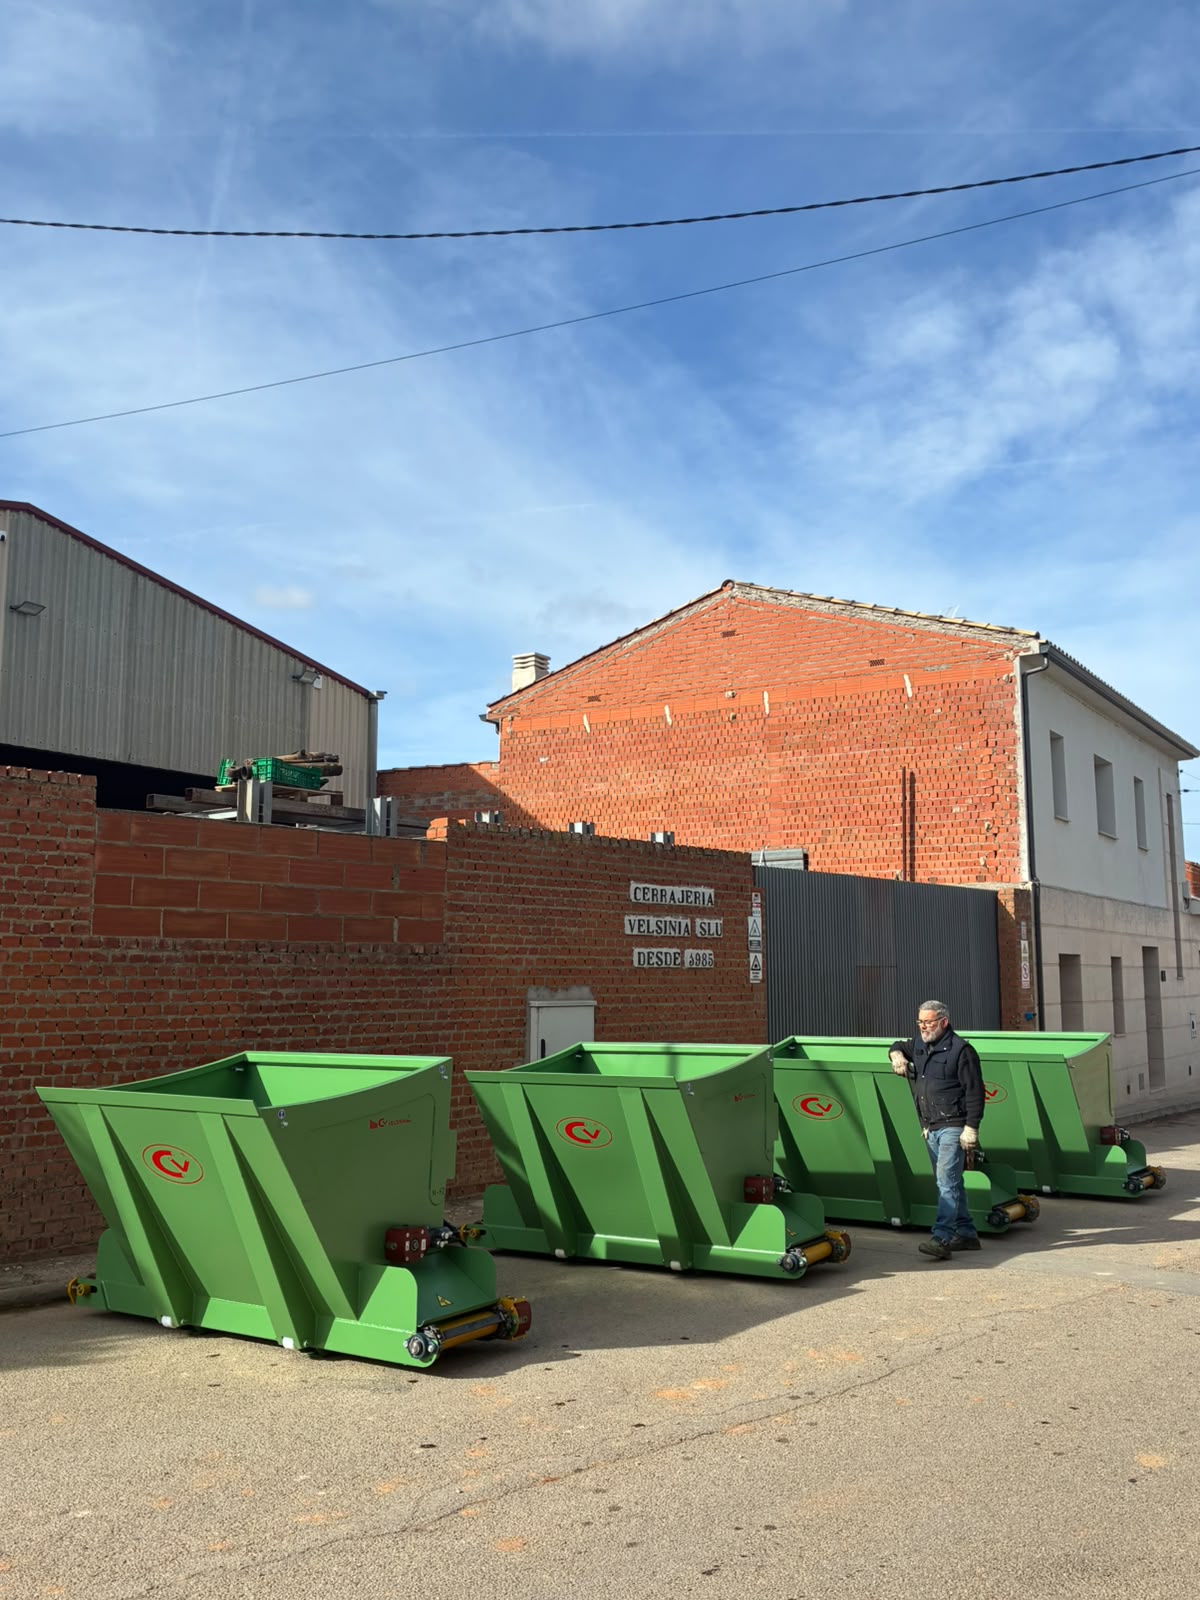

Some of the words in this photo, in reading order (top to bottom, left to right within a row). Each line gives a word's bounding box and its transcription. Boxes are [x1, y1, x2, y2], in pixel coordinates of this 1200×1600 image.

[633, 886, 715, 906] CERRAJERIA
[628, 918, 691, 936] VELSINIA
[699, 921, 723, 937] SLU
[637, 951, 681, 967] DESDE
